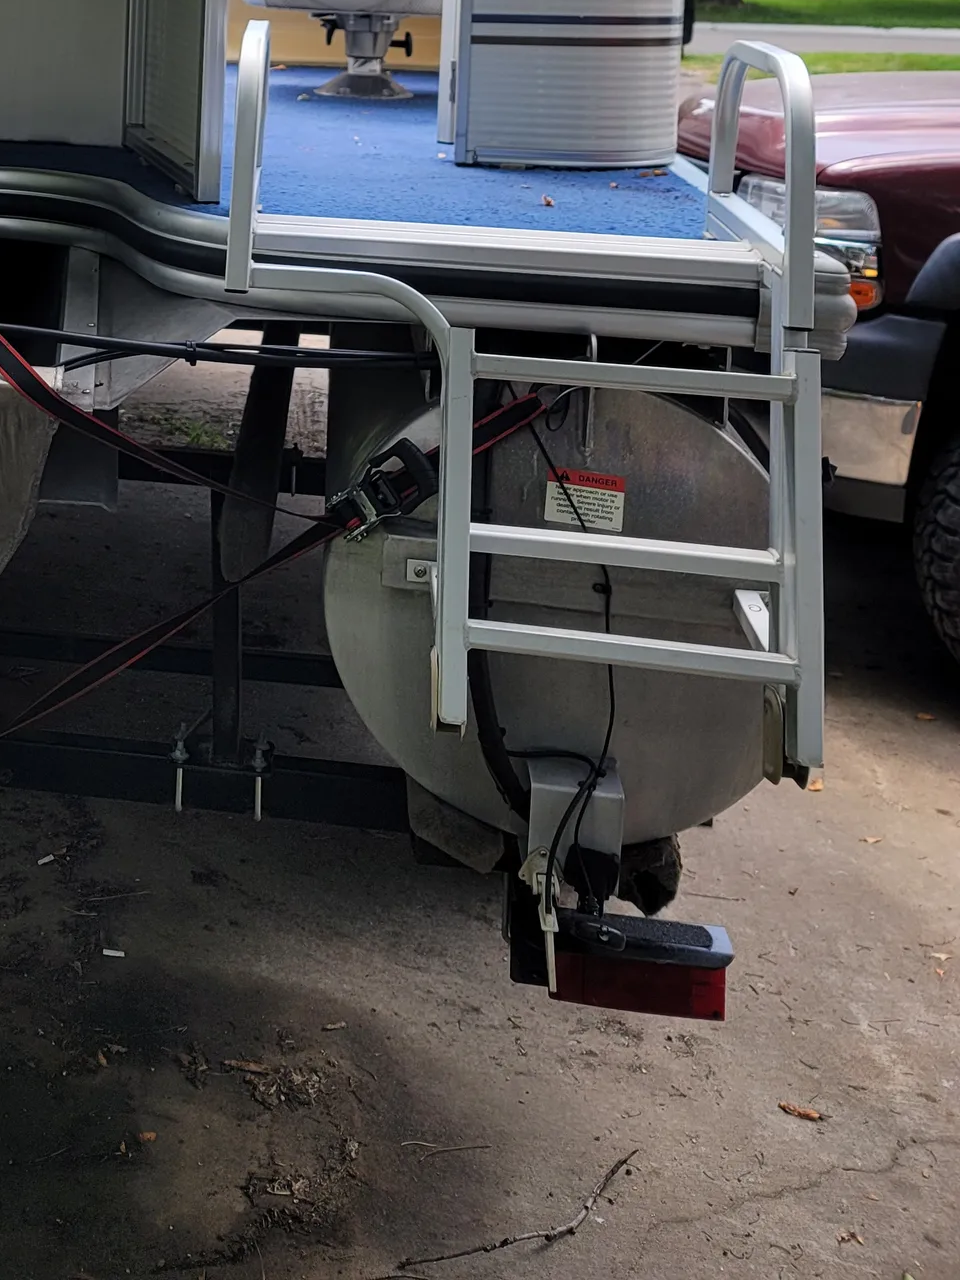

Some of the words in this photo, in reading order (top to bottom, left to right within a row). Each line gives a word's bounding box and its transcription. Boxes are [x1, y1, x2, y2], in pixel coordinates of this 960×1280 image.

[578, 474, 617, 487] DANGER
[573, 487, 600, 496] approach
[576, 493, 591, 501] when
[577, 498, 597, 506] Severe
[597, 501, 614, 510] injury
[600, 508, 615, 516] from
[591, 513, 614, 522] rotating
